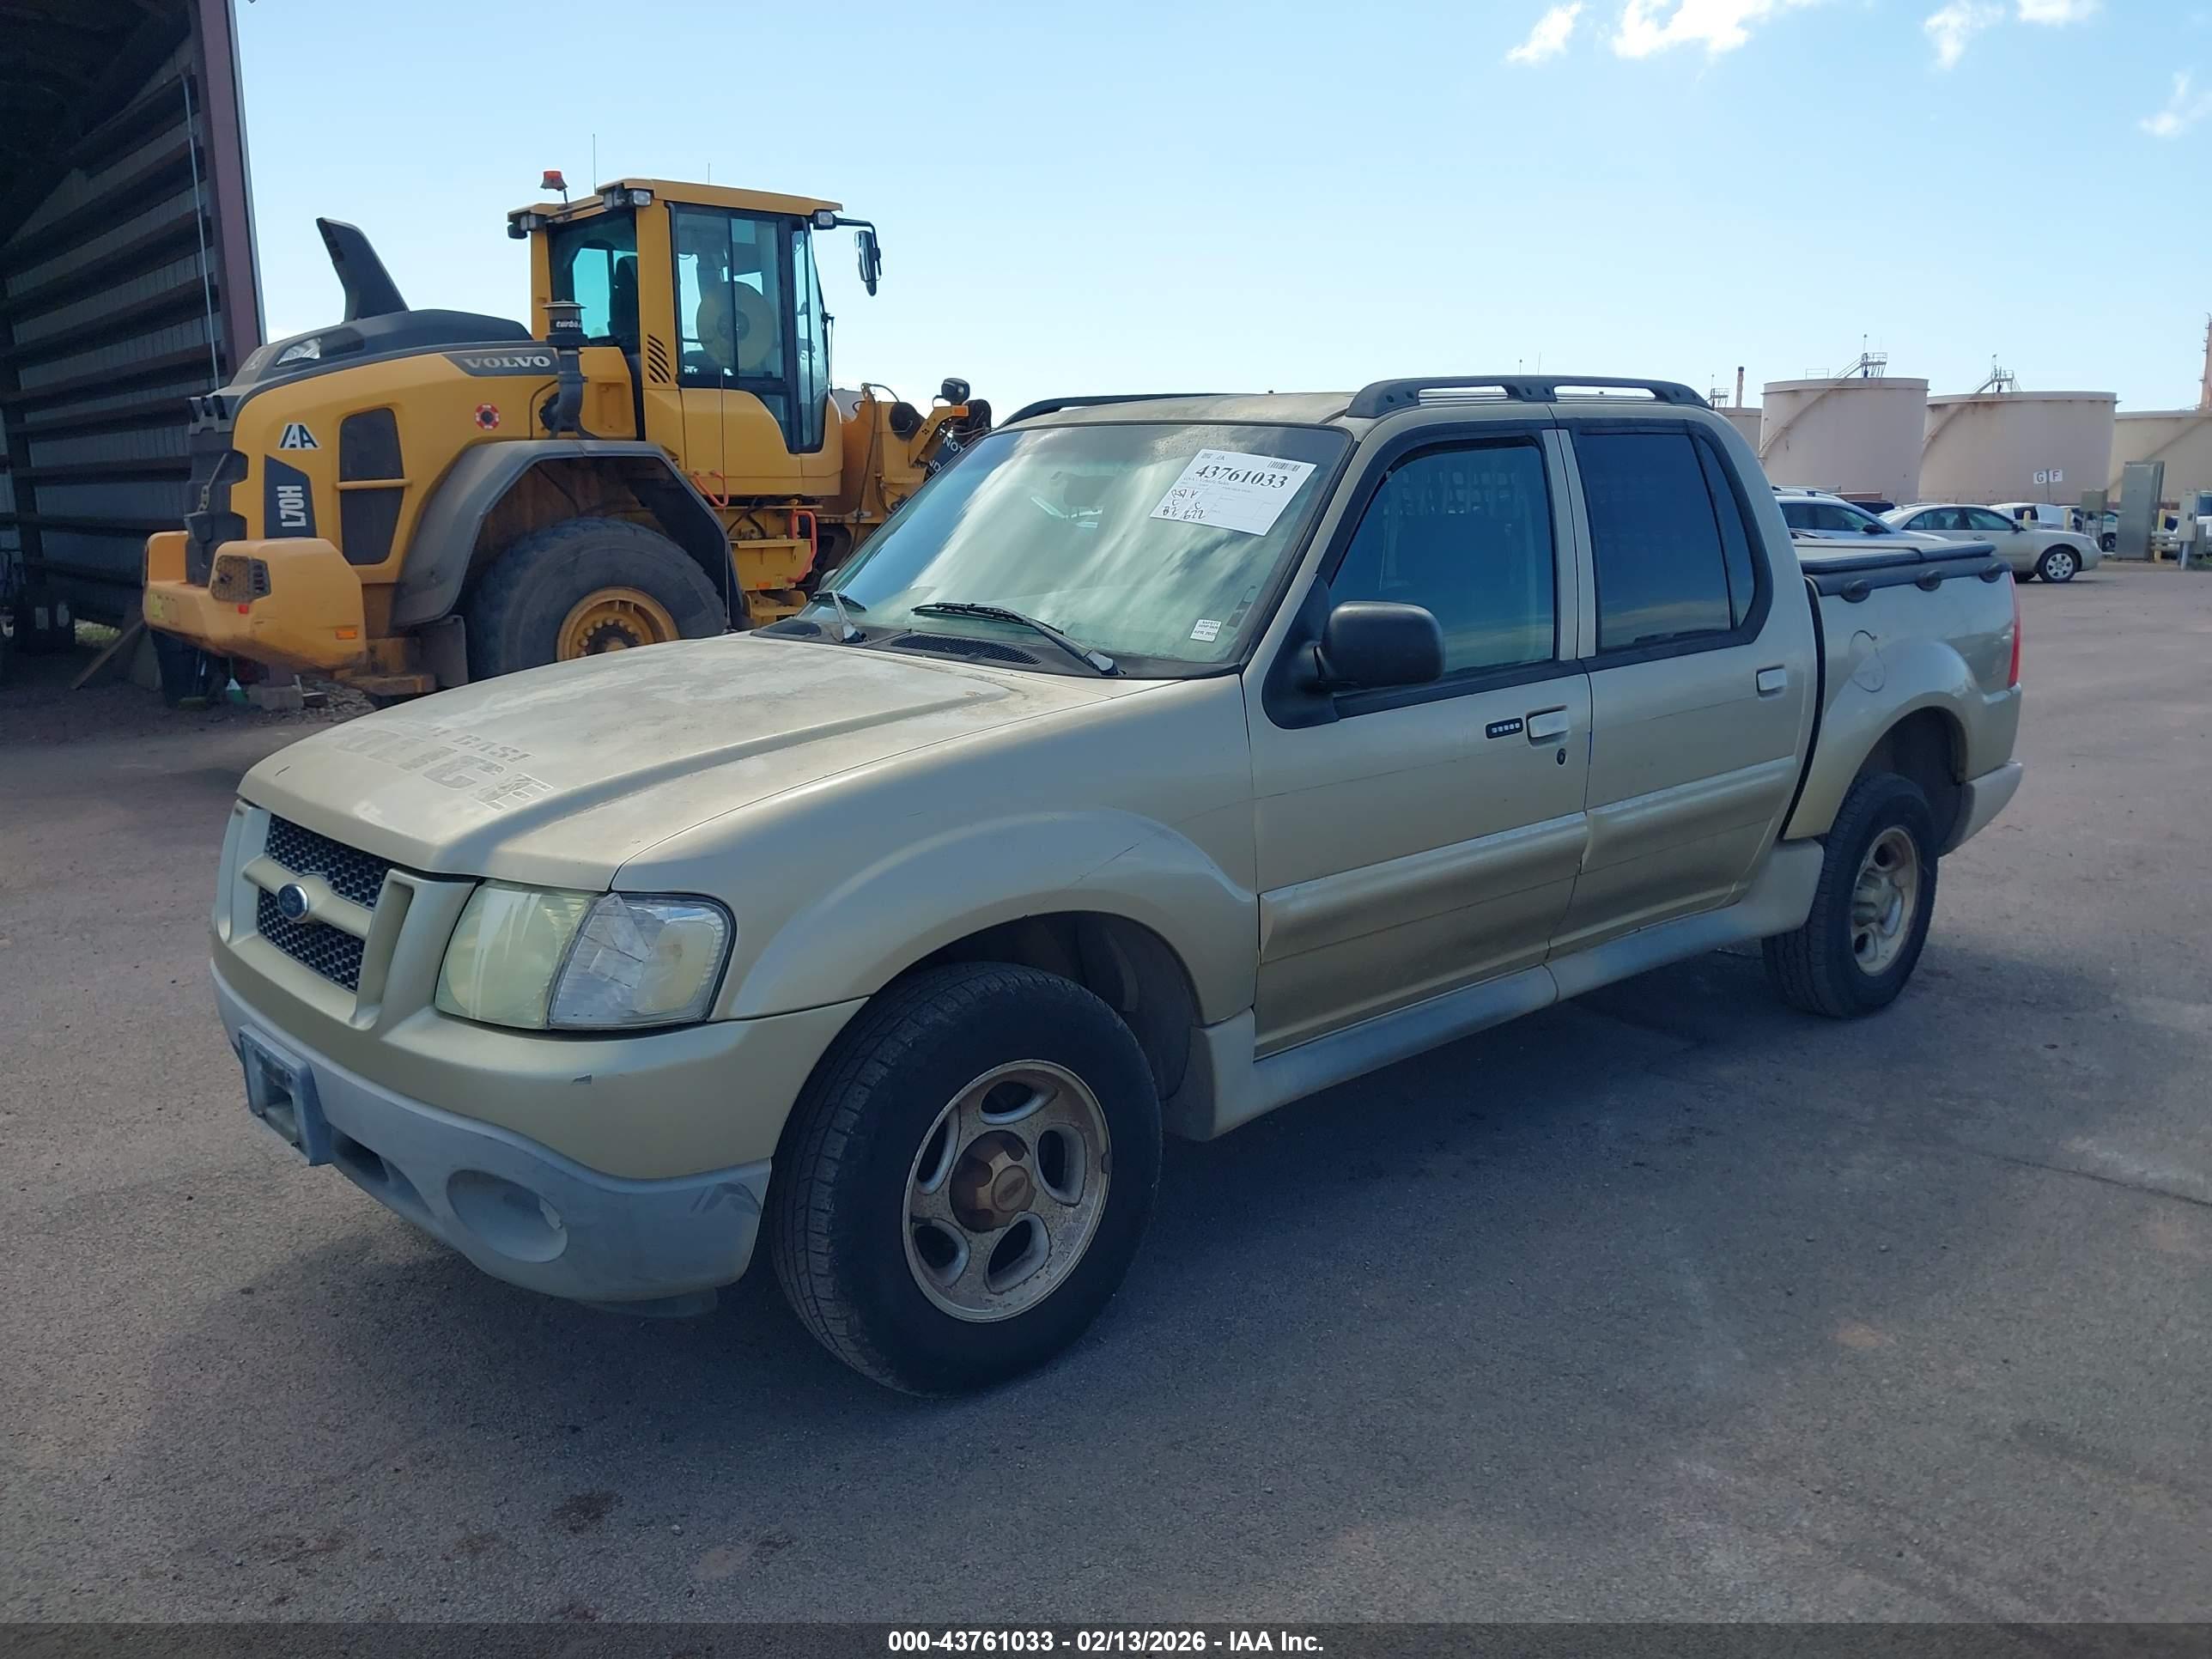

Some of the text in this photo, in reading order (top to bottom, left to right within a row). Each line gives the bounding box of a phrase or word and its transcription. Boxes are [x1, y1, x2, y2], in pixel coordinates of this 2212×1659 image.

[464, 356, 550, 368] VOLVO
[1194, 465, 1289, 489] 43761033
[2037, 472, 2044, 483] G
[2052, 470, 2060, 482] F
[276, 485, 307, 527] L70H
